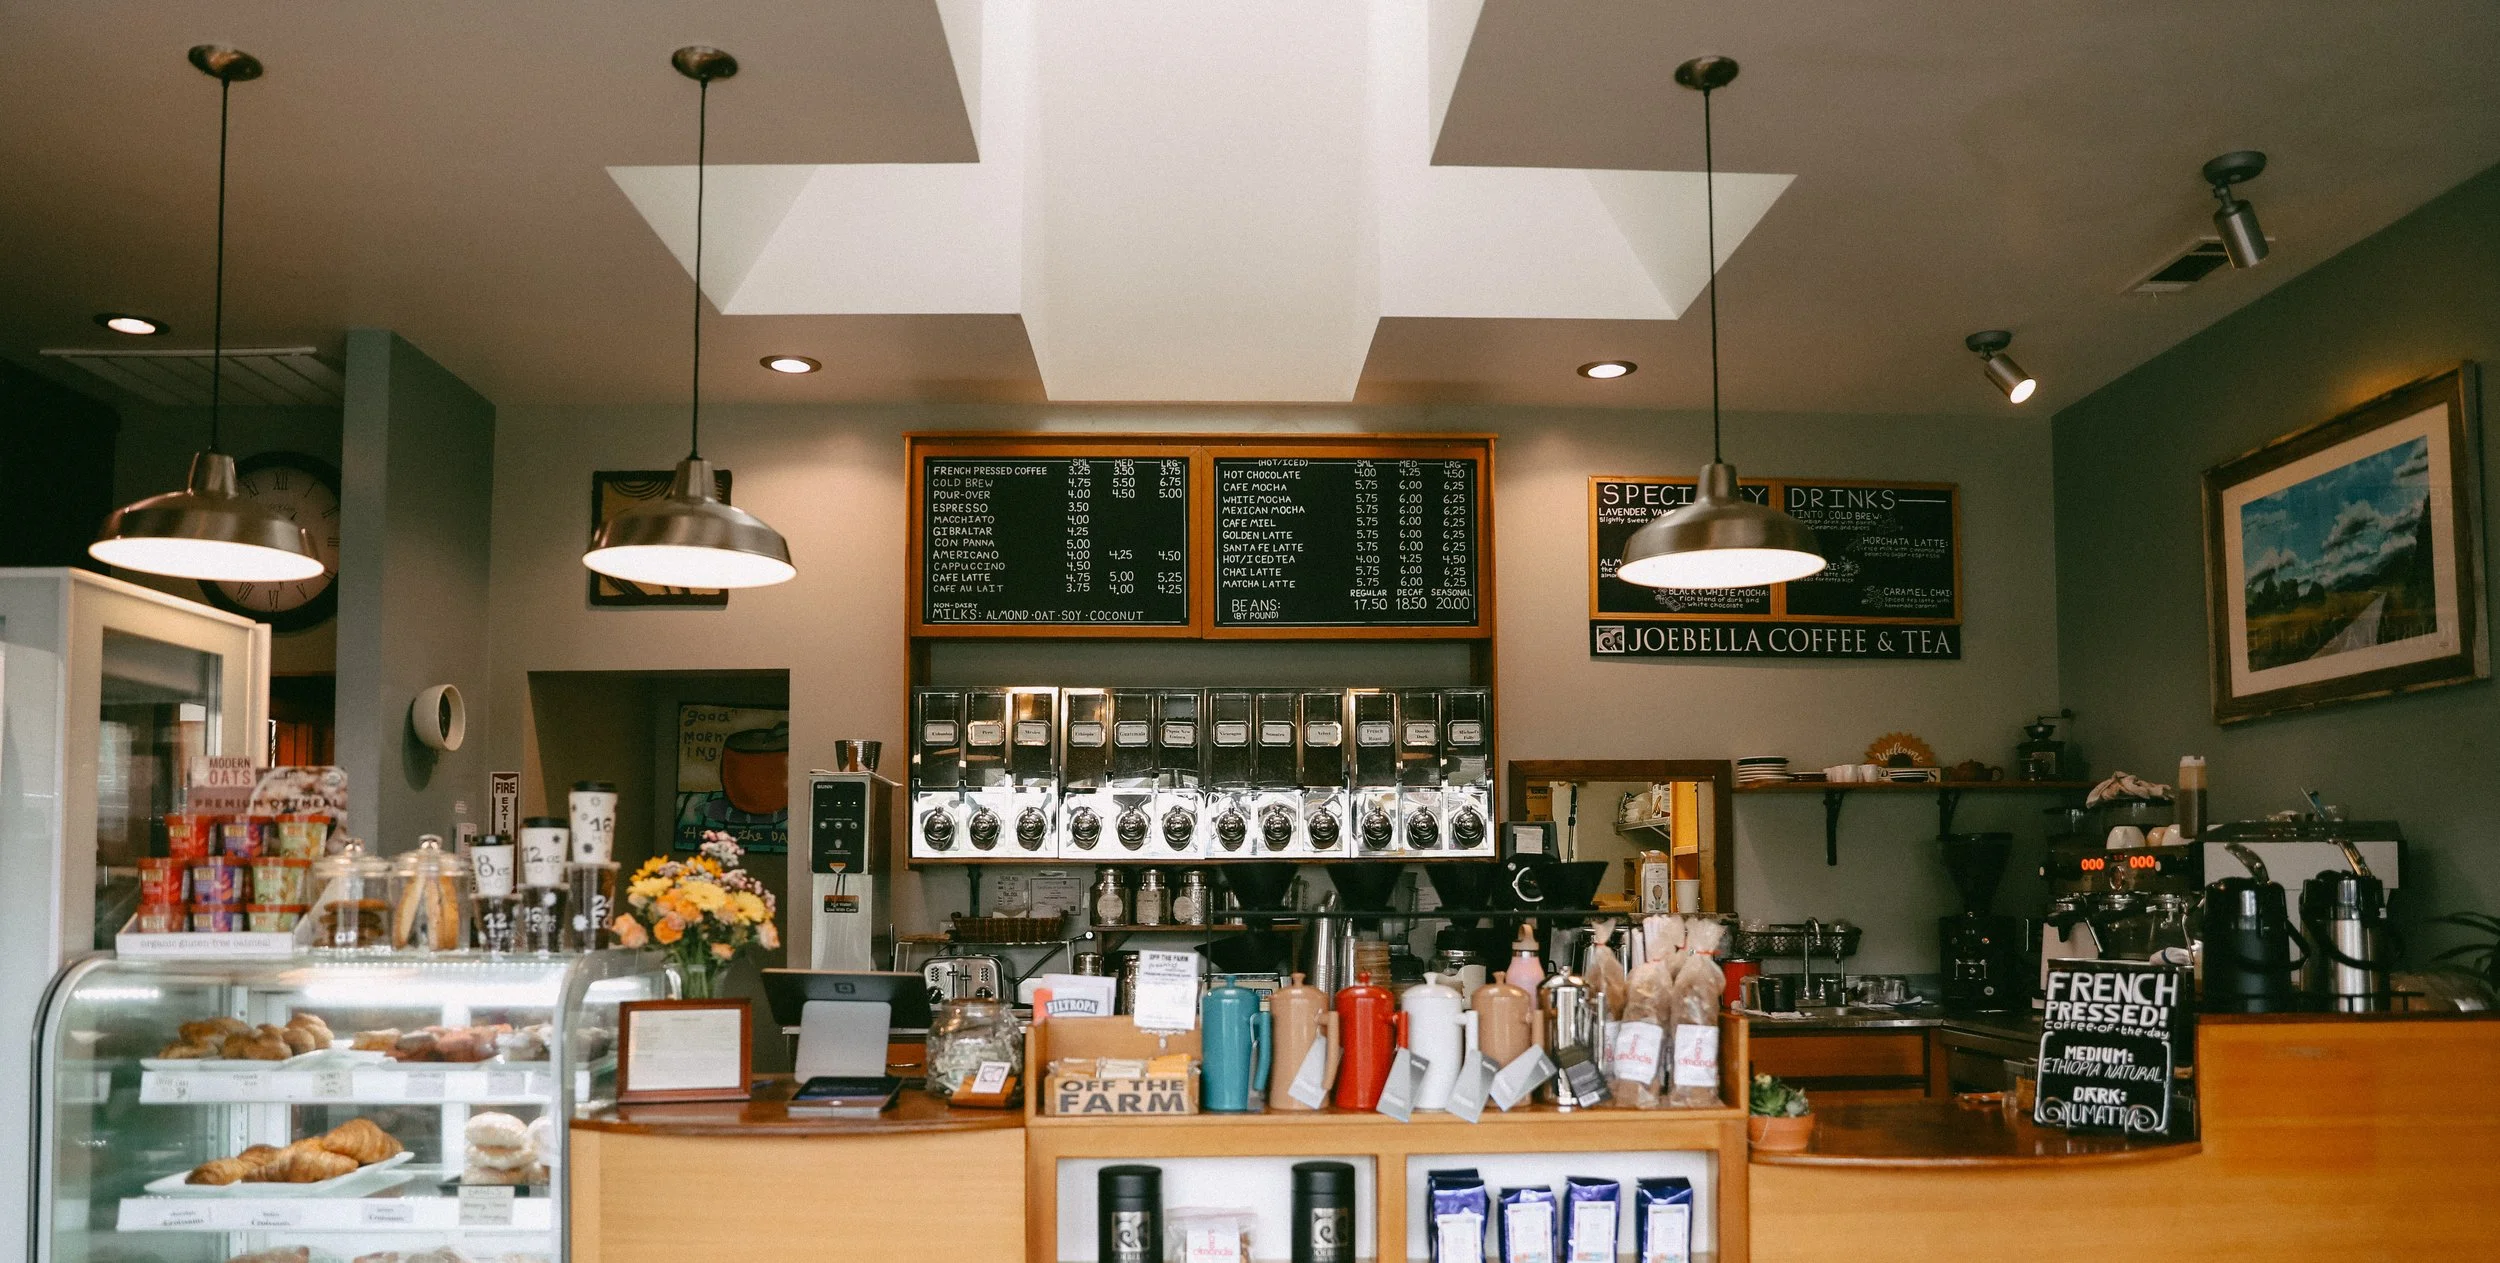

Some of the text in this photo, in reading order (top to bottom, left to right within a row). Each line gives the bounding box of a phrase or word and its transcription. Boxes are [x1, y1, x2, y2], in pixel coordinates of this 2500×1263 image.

[1073, 459, 1089, 467] SML
[1115, 459, 1133, 467] MED
[1258, 459, 1309, 467] (HOT/ICED)
[1400, 460, 1417, 468] MED
[934, 466, 1181, 476] FRENCH PRESSED COFFEE 3.25 3.50 3.75
[1224, 468, 1464, 479] HOT CHOCOLATE 4.00 4.25 4.50
[933, 478, 1181, 487] COLD BREW 4.75 5.50 6.75
[1224, 481, 1464, 491] CAFE MOCHA 5.75 6.00 6.25
[934, 489, 1182, 499] POUR-OVER 4.00 4.50 5.00
[1258, 495, 1291, 503] MOCHA
[1603, 485, 1765, 505] SPECIY
[1792, 488, 1895, 510] DRINKS
[933, 502, 1088, 512] ESPRESSO 3.50
[1222, 506, 1305, 514] MEXICAN MOCHA
[1599, 508, 1646, 516] LAVENDER
[1068, 515, 1089, 524] 4.00
[1829, 511, 1852, 519] COLD
[1855, 512, 1882, 520] BREW:
[1223, 519, 1276, 527] CAFE MIEL
[933, 527, 1088, 536] GIBRALTAR 4.25
[1223, 531, 1292, 539] GOLDEN LATTE
[964, 539, 994, 547] PANNA
[1067, 539, 1090, 549] 5.00
[1863, 537, 1948, 548] HORCHATA LATTE:
[1273, 544, 1303, 552] LATTE
[933, 551, 1180, 561] AMERICANO 4.00 4.25 4.50
[1223, 554, 1466, 564] HOT/ICED TEA 4.00 4.25 4.50
[934, 562, 1090, 571] CAPPUCCINO 4.50
[1223, 567, 1281, 576] CHAI LATTE
[933, 572, 1182, 582] CAFE LATTE 4.75 5.00 5.25
[1066, 583, 1090, 592] 3.75
[1109, 584, 1133, 594] 4.00
[1158, 584, 1181, 593] 4.25
[1223, 579, 1295, 588] MATCHA LATTE
[1350, 589, 1387, 597] REGULAR
[1884, 588, 1952, 597] CARAMEL CHAI:
[1232, 598, 1469, 612] BEANS: 17.50 18.50 20.00
[933, 609, 981, 620] MILKS:
[1234, 612, 1247, 620] (BY
[1629, 628, 1952, 654] JOEBELLA COFFEE & TEA
[1876, 743, 1924, 764] Welcome
[210, 759, 250, 769] MODERN
[210, 771, 250, 785] OATS
[496, 782, 515, 793] FIRE
[589, 818, 613, 832] 16
[478, 856, 494, 878] 8
[2047, 972, 2178, 1007] FRENCH
[1046, 999, 1098, 1014] FILTROPA
[2045, 1001, 2168, 1028] PRESSED!
[2065, 1045, 2134, 1065] MEDIUM:
[2042, 1058, 2162, 1082] ETHIOPIA NATURAL
[1060, 1079, 1184, 1091] OFF THE
[1060, 1093, 1184, 1112] FARM
